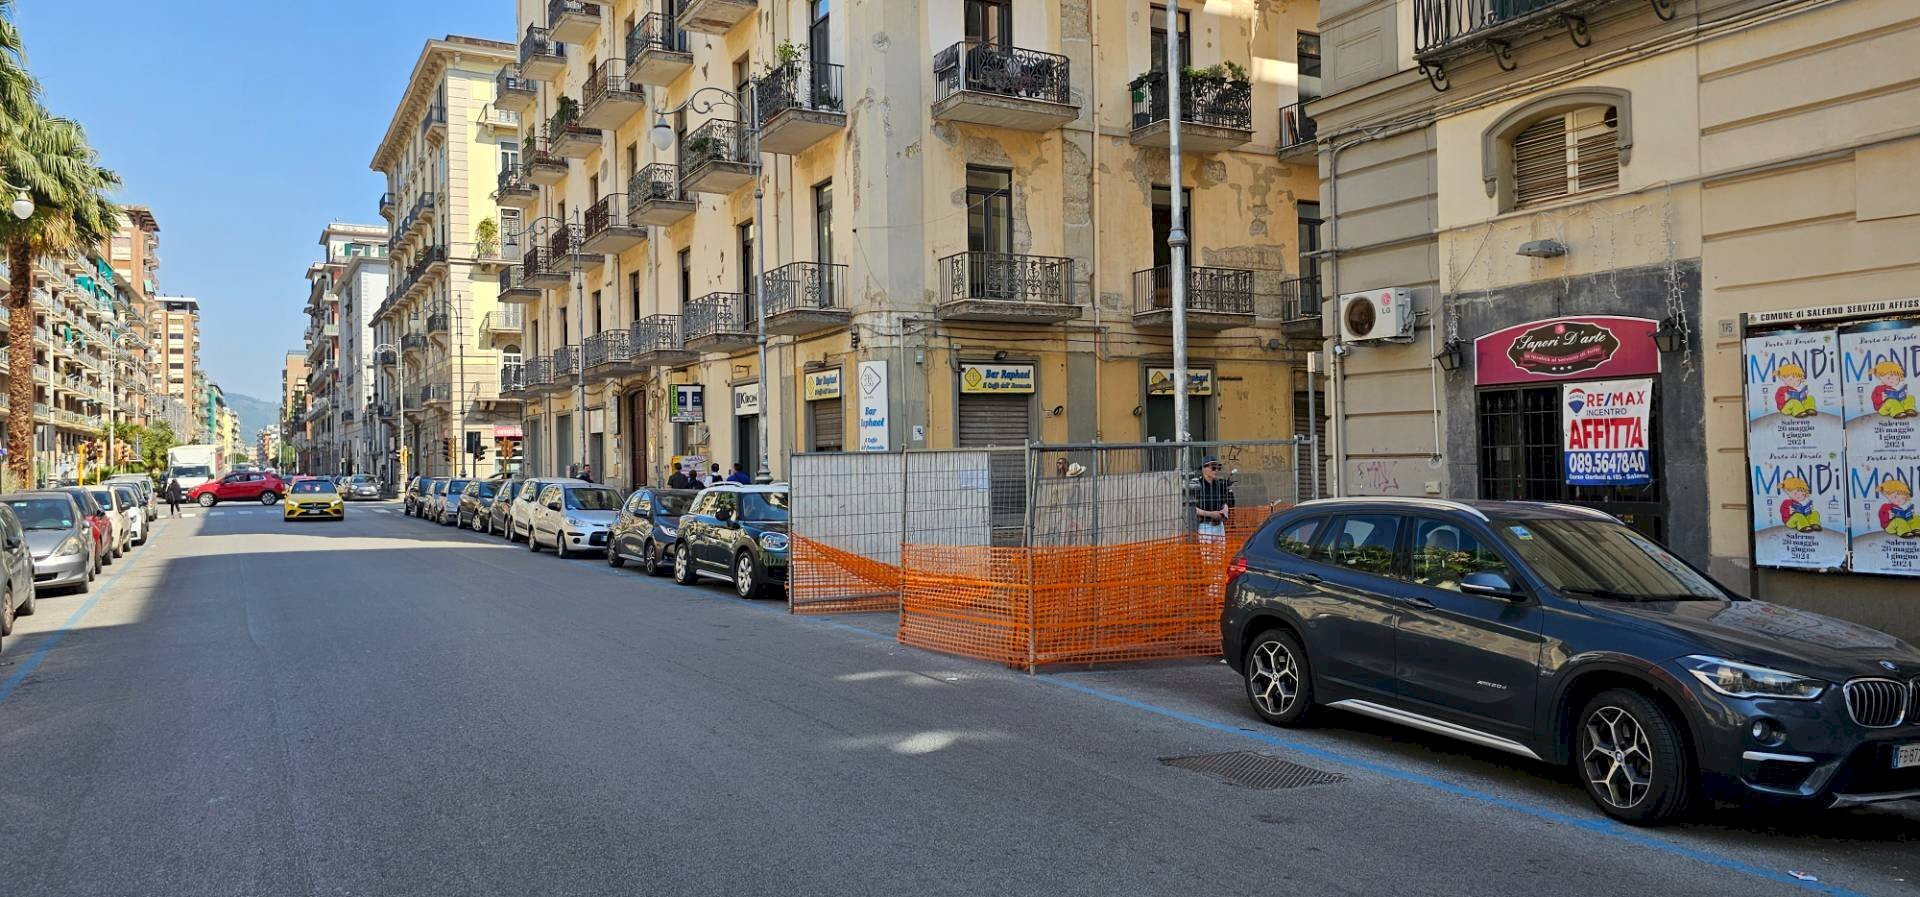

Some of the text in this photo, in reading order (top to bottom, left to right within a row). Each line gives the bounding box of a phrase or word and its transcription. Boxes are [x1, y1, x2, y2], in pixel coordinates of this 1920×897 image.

[1760, 313, 1793, 321] COMUNE
[1807, 308, 1843, 317] SALERNO
[1847, 303, 1885, 313] SERVIZIO
[1889, 300, 1919, 309] AFFISS
[1516, 331, 1606, 352] Sapori D'arte
[986, 368, 1031, 381] Bar Raphael
[1587, 391, 1646, 407] RE/MAX
[864, 407, 877, 415] Bar
[1586, 407, 1627, 416] INCENTRO
[1569, 416, 1644, 449] AFFITTA
[1886, 426, 1914, 434] maggio
[1569, 452, 1645, 473] 089.5647840
[1793, 539, 1819, 547] maggio
[1891, 552, 1919, 560] giugno
